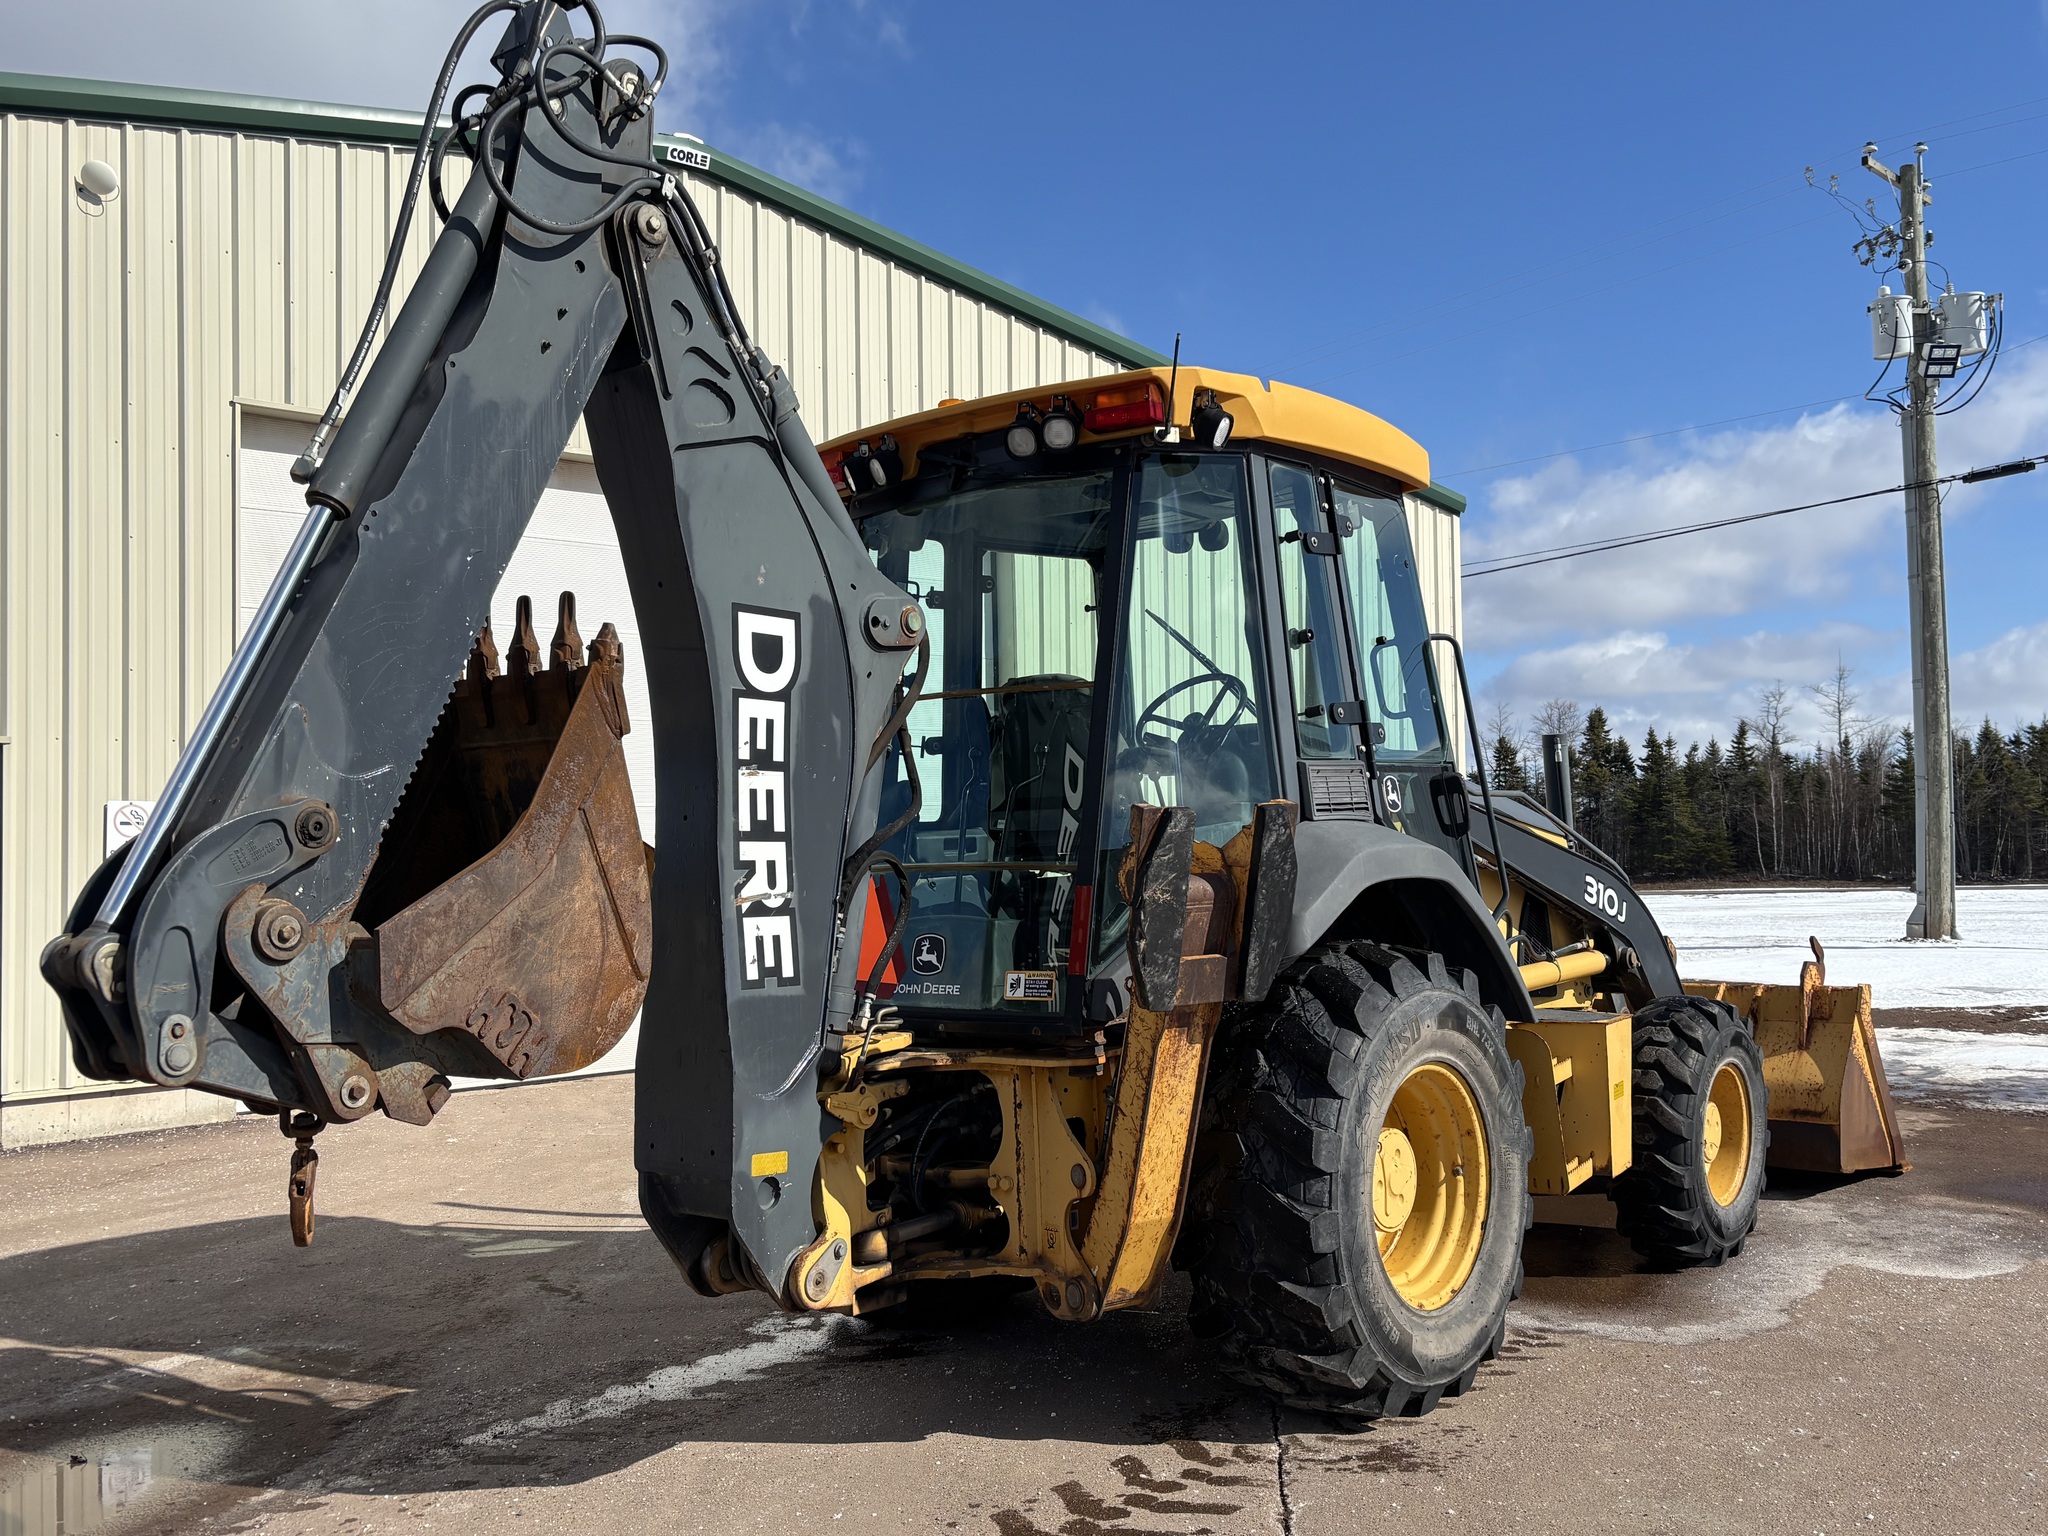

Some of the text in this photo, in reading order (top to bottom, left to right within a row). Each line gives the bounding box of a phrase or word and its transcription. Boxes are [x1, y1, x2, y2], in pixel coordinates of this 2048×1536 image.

[670, 148, 708, 167] CORLE
[737, 611, 797, 982] DEERE
[1584, 875, 1627, 923] 310J
[894, 982, 961, 995] JOHN DEERE
[1466, 1015, 1480, 1038] BHL
